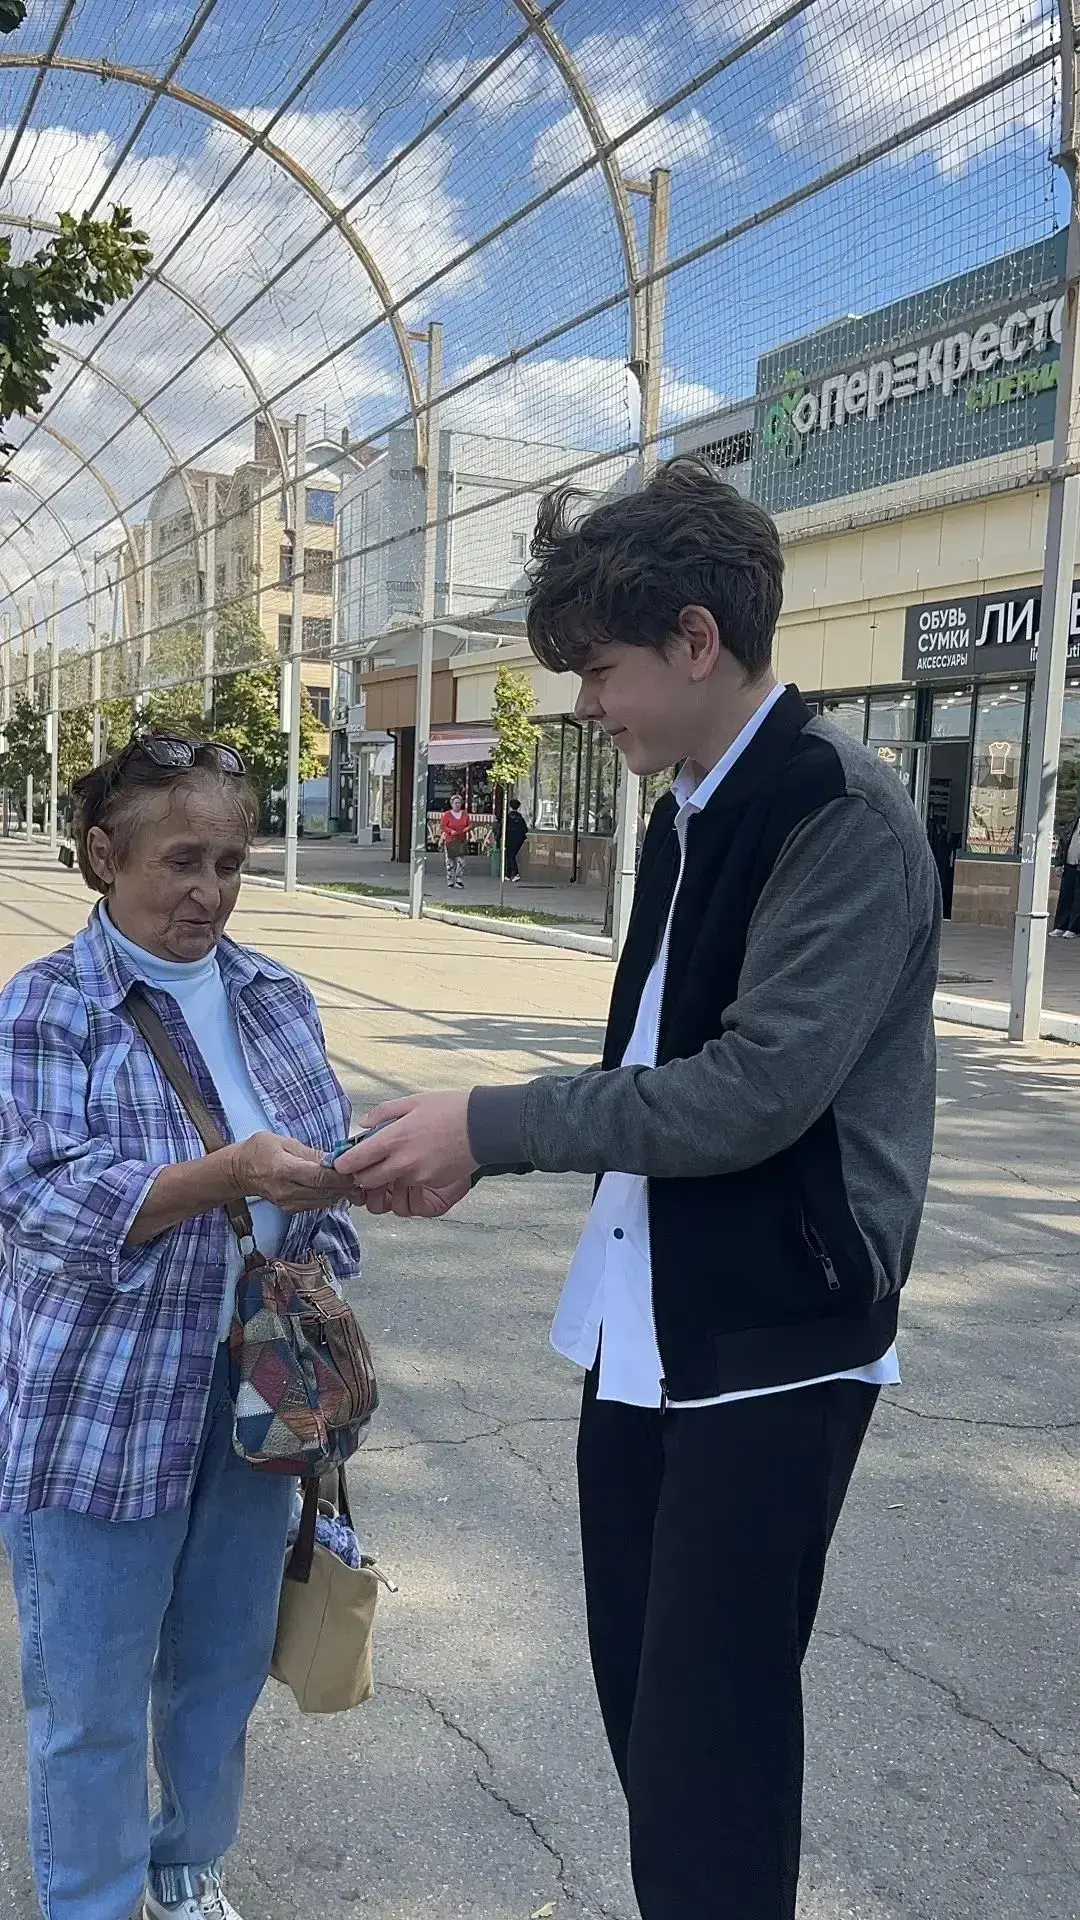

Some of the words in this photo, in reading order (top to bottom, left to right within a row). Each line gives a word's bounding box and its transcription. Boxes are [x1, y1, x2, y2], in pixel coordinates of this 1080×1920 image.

[919, 607, 967, 631] ОБУВЬ
[918, 628, 970, 652] СУМКИ
[917, 652, 968, 670] АКСЕССУАРЫ
